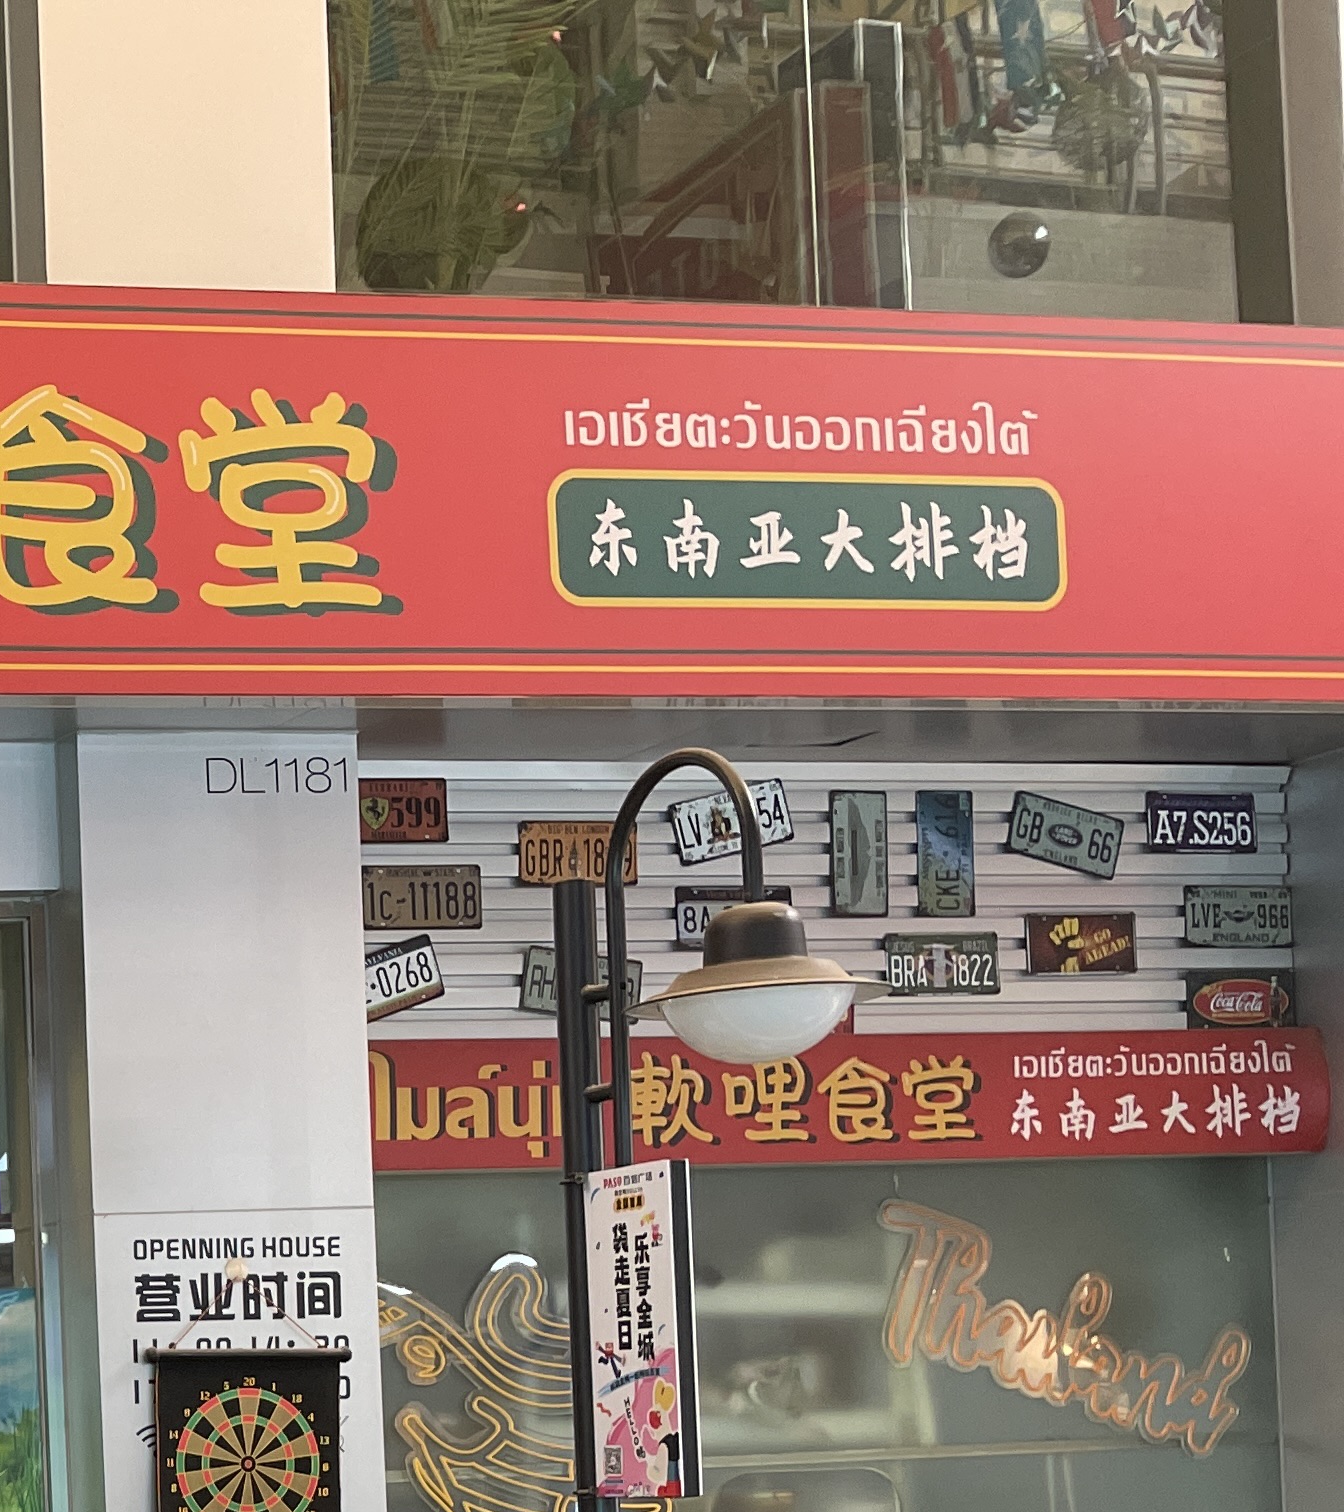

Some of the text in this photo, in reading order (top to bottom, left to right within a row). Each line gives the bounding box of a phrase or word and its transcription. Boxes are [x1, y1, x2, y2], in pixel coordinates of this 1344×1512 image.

[587, 497, 1030, 583] 东南亚大排档
[203, 754, 351, 797] DL1181
[390, 796, 442, 829] 599
[1015, 806, 1045, 844] GB
[1087, 828, 1115, 864] 66
[524, 837, 565, 878] GBR
[935, 869, 961, 912] CKE
[1092, 928, 1112, 944] GO
[1190, 902, 1290, 929] LVE 966
[890, 953, 995, 988] BRA 1822
[630, 1050, 983, 1148] 軟哩食堂
[1009, 1083, 1302, 1141] 东南亚大排档
[133, 1235, 342, 1261] OPENNING HOUSE
[134, 1270, 343, 1324] 营业时间
[612, 1222, 633, 1350] 袋走夏日
[634, 1231, 656, 1361] 乐享全城
[242, 1376, 256, 1387] 20
